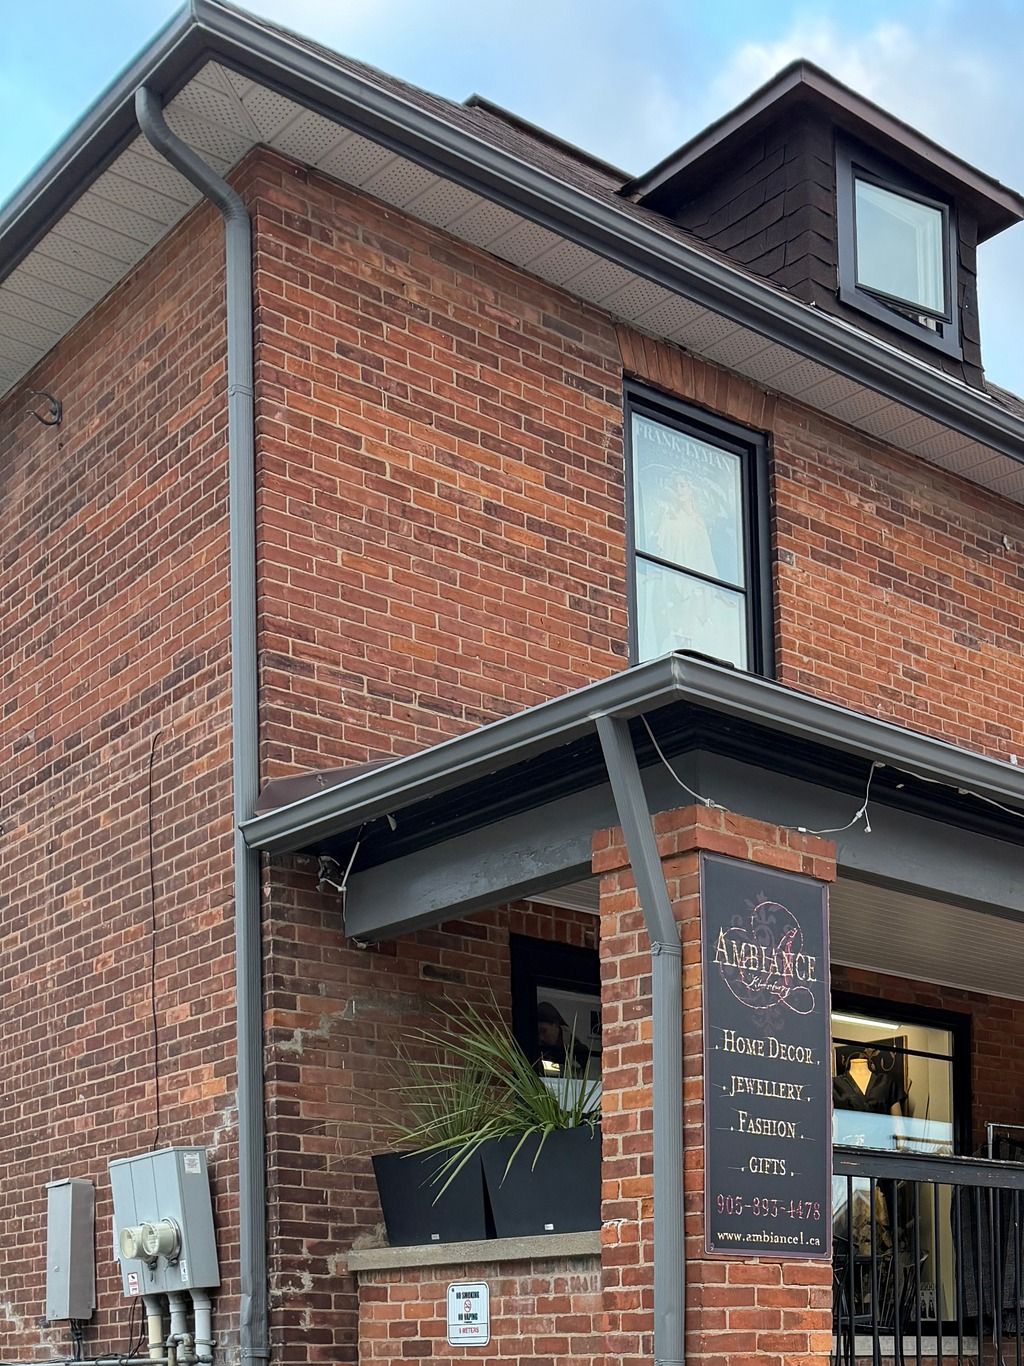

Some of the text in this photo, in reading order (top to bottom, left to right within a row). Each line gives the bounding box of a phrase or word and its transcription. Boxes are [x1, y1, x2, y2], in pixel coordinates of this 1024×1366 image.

[713, 927, 817, 982] AMBIANCE
[723, 1029, 813, 1064] HOME DECOR
[729, 1075, 804, 1101] JEWELLERY
[738, 1110, 796, 1138] FASHION
[749, 1156, 786, 1176] GIFTS
[716, 1193, 821, 1221] 905-893-4478
[462, 1291, 480, 1299] SMOKING
